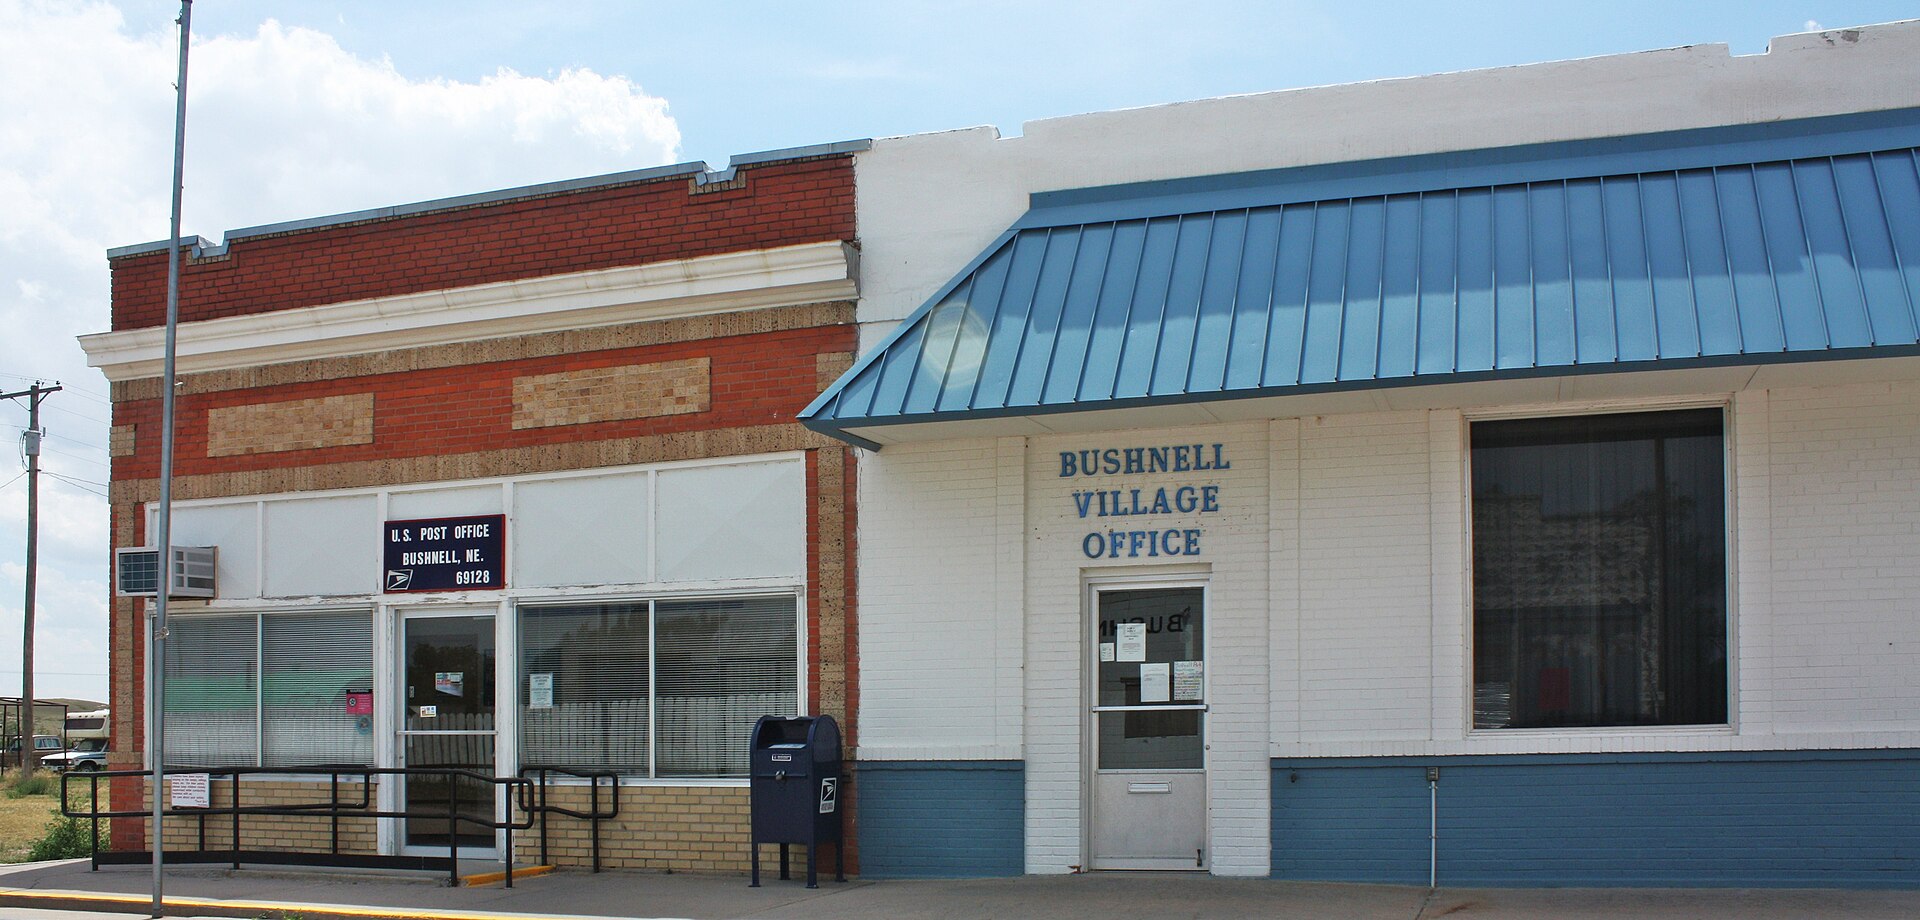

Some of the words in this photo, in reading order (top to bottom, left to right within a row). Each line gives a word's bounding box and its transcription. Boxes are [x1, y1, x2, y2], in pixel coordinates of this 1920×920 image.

[1059, 444, 1230, 477] BUSHNELL
[1072, 486, 1219, 518] VILLAGE
[421, 526, 448, 541] POST
[454, 523, 490, 540] OFFICE
[1083, 529, 1201, 559] OFFICE
[402, 549, 461, 566] BUSHNELL,
[466, 548, 484, 563] NE.
[456, 569, 490, 585] 69128
